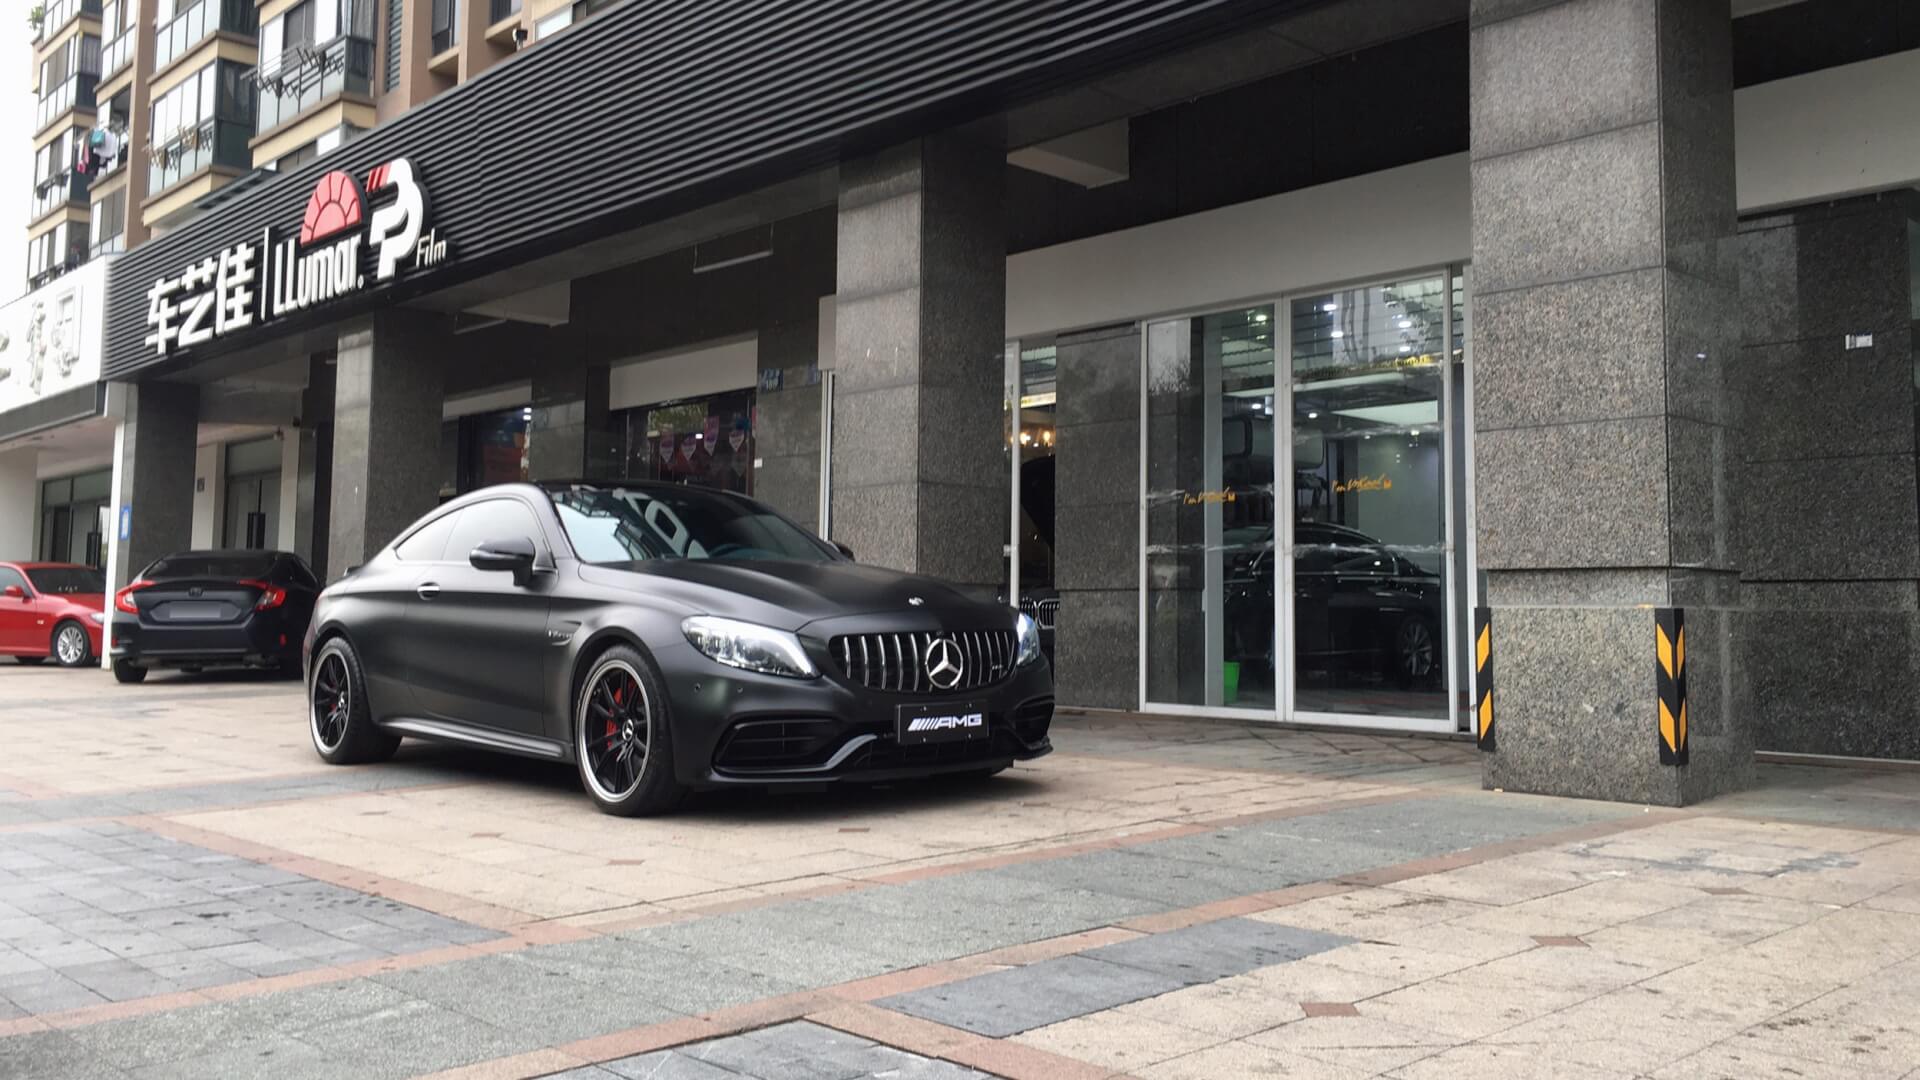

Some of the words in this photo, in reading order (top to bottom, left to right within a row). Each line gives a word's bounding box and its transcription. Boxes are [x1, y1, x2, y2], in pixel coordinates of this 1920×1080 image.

[416, 227, 447, 268] Film
[145, 242, 256, 354] 车艺佳
[936, 713, 982, 729] AMG
